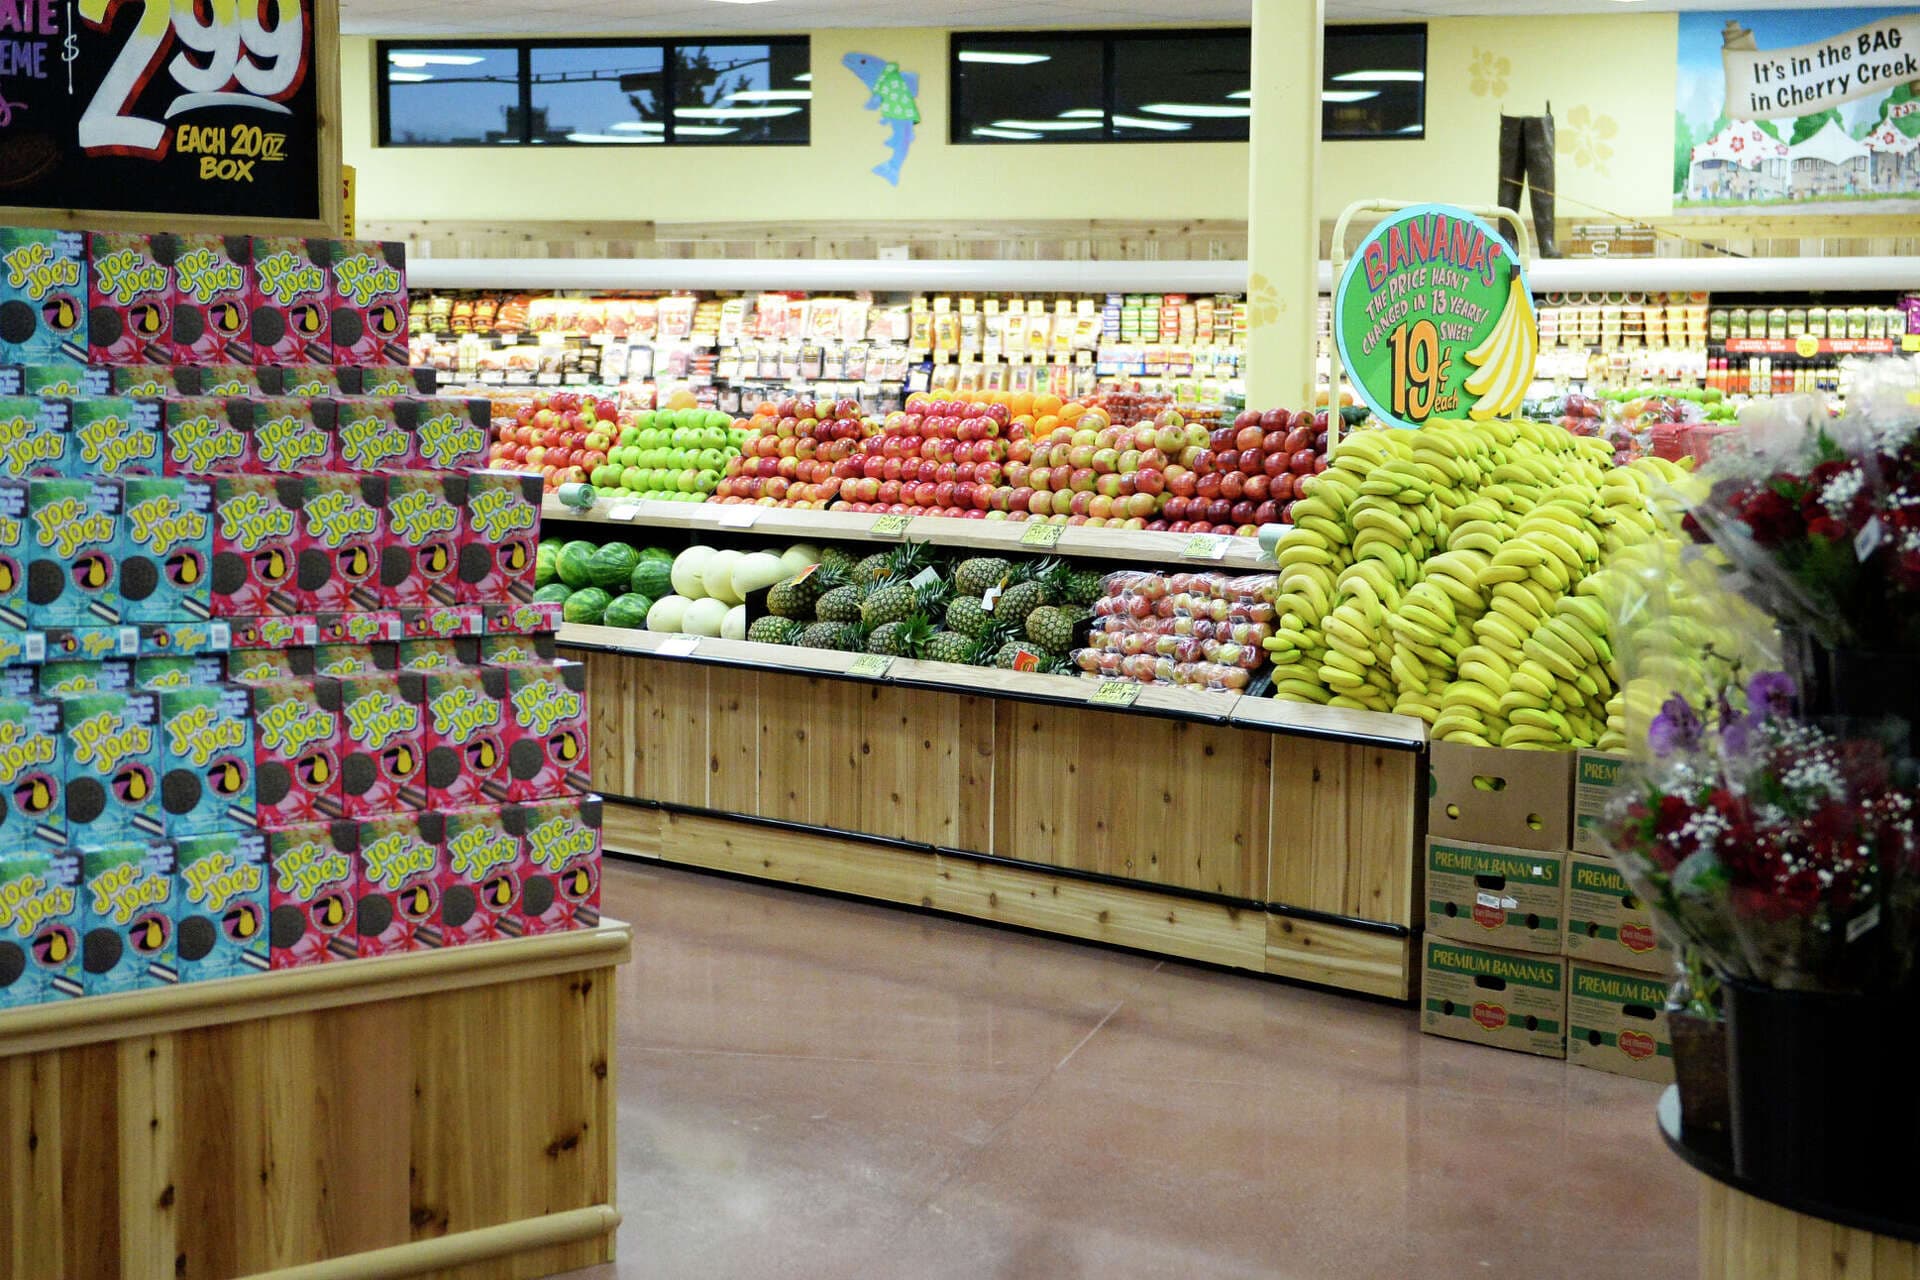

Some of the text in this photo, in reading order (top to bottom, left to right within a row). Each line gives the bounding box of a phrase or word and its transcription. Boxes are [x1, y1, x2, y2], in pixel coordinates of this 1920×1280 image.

[1754, 28, 1902, 84] It's in the BAG
[1751, 53, 1917, 111] in Cherry Creek
[176, 124, 225, 154] EACH
[200, 157, 254, 182] BOX
[5, 243, 51, 285] Joe-
[98, 251, 140, 292] Joe-
[176, 249, 218, 290] Joe-
[256, 252, 299, 294] Joe-
[337, 254, 377, 294] Joe-
[1363, 212, 1503, 293] BANANAS
[28, 258, 79, 299] Joe's
[118, 263, 166, 302] Joe's
[196, 261, 242, 300] Joe's
[277, 265, 323, 304] Joe's
[357, 266, 400, 304] Joe's
[1366, 267, 1469, 320] THE PRICE HASN'T
[1362, 289, 1489, 356] CHANGED IN 13 YEARS!
[1434, 387, 1458, 414] each
[9, 433, 62, 474] Joe's
[79, 417, 128, 460] Joe-
[103, 433, 154, 472] Joe's
[169, 418, 217, 460] Joe-
[191, 433, 243, 470] Joe's
[257, 417, 302, 460] Joe-
[279, 432, 327, 469] Joe's
[340, 415, 385, 460] Joe-
[362, 430, 410, 469] Joe's
[418, 415, 460, 456] Joe-
[438, 430, 484, 466] Joe's
[36, 500, 85, 546] Joe-
[127, 497, 178, 542] Joe-
[220, 492, 267, 538] Joe-
[242, 509, 293, 549] Joe's
[305, 491, 351, 535] Joe-
[326, 507, 377, 546] Joe's
[386, 492, 433, 535] Joe-
[408, 505, 458, 544] Joe's
[469, 489, 513, 531] Joe-
[488, 503, 535, 541] Joe's
[58, 515, 113, 557] Joe's
[153, 512, 206, 555] Joe's
[259, 700, 308, 747] Joe-
[348, 692, 391, 740] Joe-
[431, 688, 475, 733] Joe-
[451, 699, 501, 743] Joe's
[514, 681, 557, 726] Joe-
[533, 690, 580, 735] Joe's
[71, 714, 120, 762] Joe-
[167, 707, 217, 754] Joe-
[190, 721, 244, 766] Joe's
[282, 714, 334, 757] Joe's
[368, 705, 417, 749] Joe's
[0, 735, 54, 782] Joe's
[97, 727, 151, 773] Joe's
[363, 834, 409, 881] Joe-
[450, 827, 495, 873] Joe-
[469, 836, 519, 881] Joe's
[529, 818, 572, 863] Joe-
[548, 828, 596, 871] Joe's
[185, 854, 234, 903] Joe-
[207, 864, 260, 910] Joe's
[278, 844, 322, 892] Joe-
[300, 855, 349, 900] Joe's
[384, 845, 435, 890] Joe's
[1435, 851, 1553, 880] PREMIUM BANANS
[90, 864, 139, 913] Joe-
[114, 875, 170, 924] Joe's
[16, 887, 75, 937] Joe's
[1433, 949, 1489, 973] PREMIUM
[1492, 960, 1554, 984] BANANAS
[1579, 976, 1638, 999] PREMIUM
